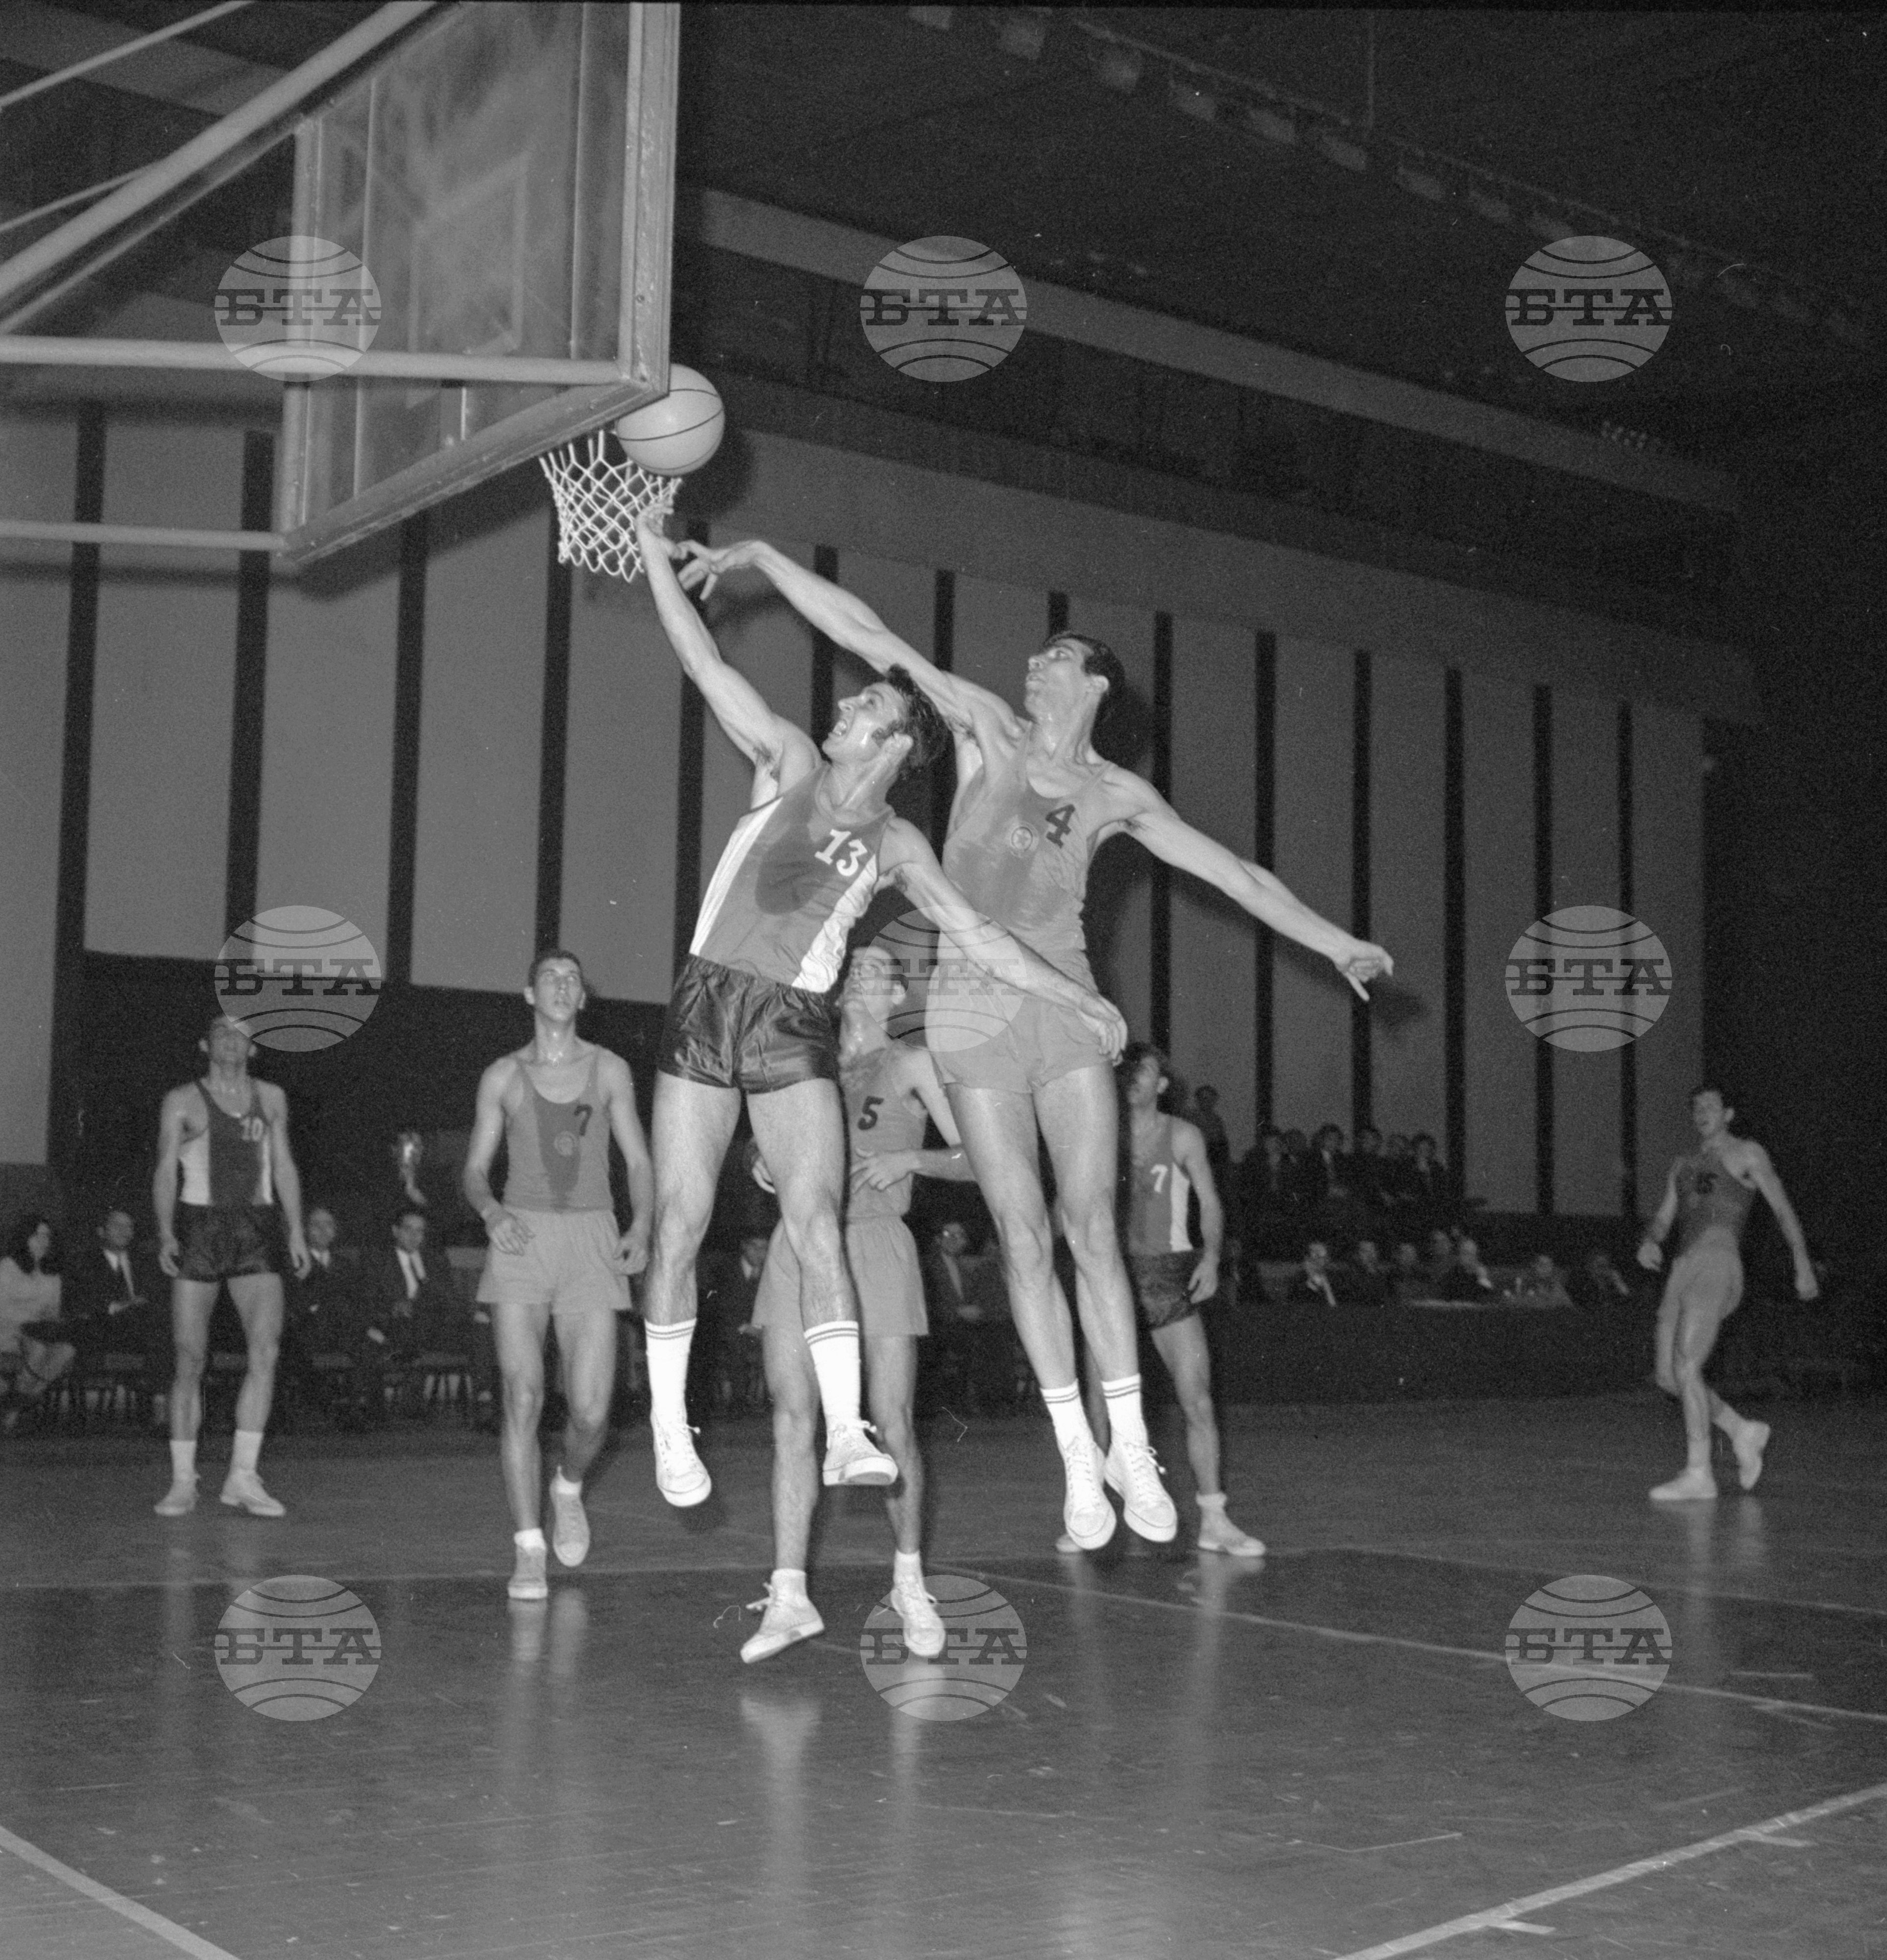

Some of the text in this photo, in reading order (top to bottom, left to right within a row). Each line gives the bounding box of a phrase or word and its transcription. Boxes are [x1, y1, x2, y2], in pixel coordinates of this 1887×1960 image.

[1045, 804, 1075, 849] 4
[814, 829, 868, 876] 13
[240, 1117, 264, 1142] 10
[574, 1104, 593, 1136] 7
[857, 1096, 884, 1131] 5
[1150, 1164, 1168, 1193] 7
